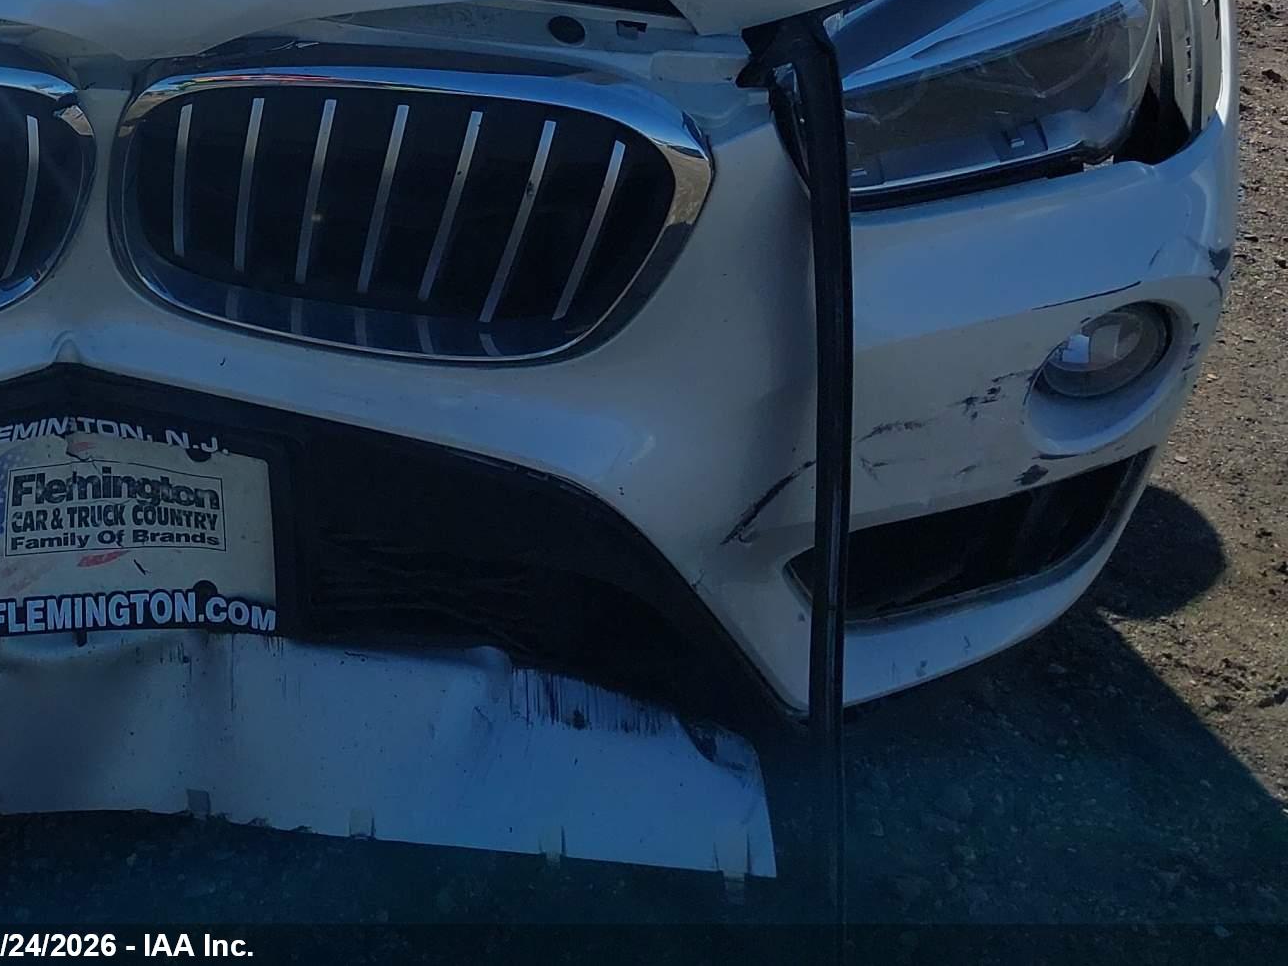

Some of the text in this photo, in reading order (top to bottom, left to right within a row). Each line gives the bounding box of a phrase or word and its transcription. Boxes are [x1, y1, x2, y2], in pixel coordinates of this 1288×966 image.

[12, 466, 220, 510] Flemington
[11, 504, 218, 533] CAR & TRUCK COUNTRY
[10, 529, 220, 551] Family Of Brands
